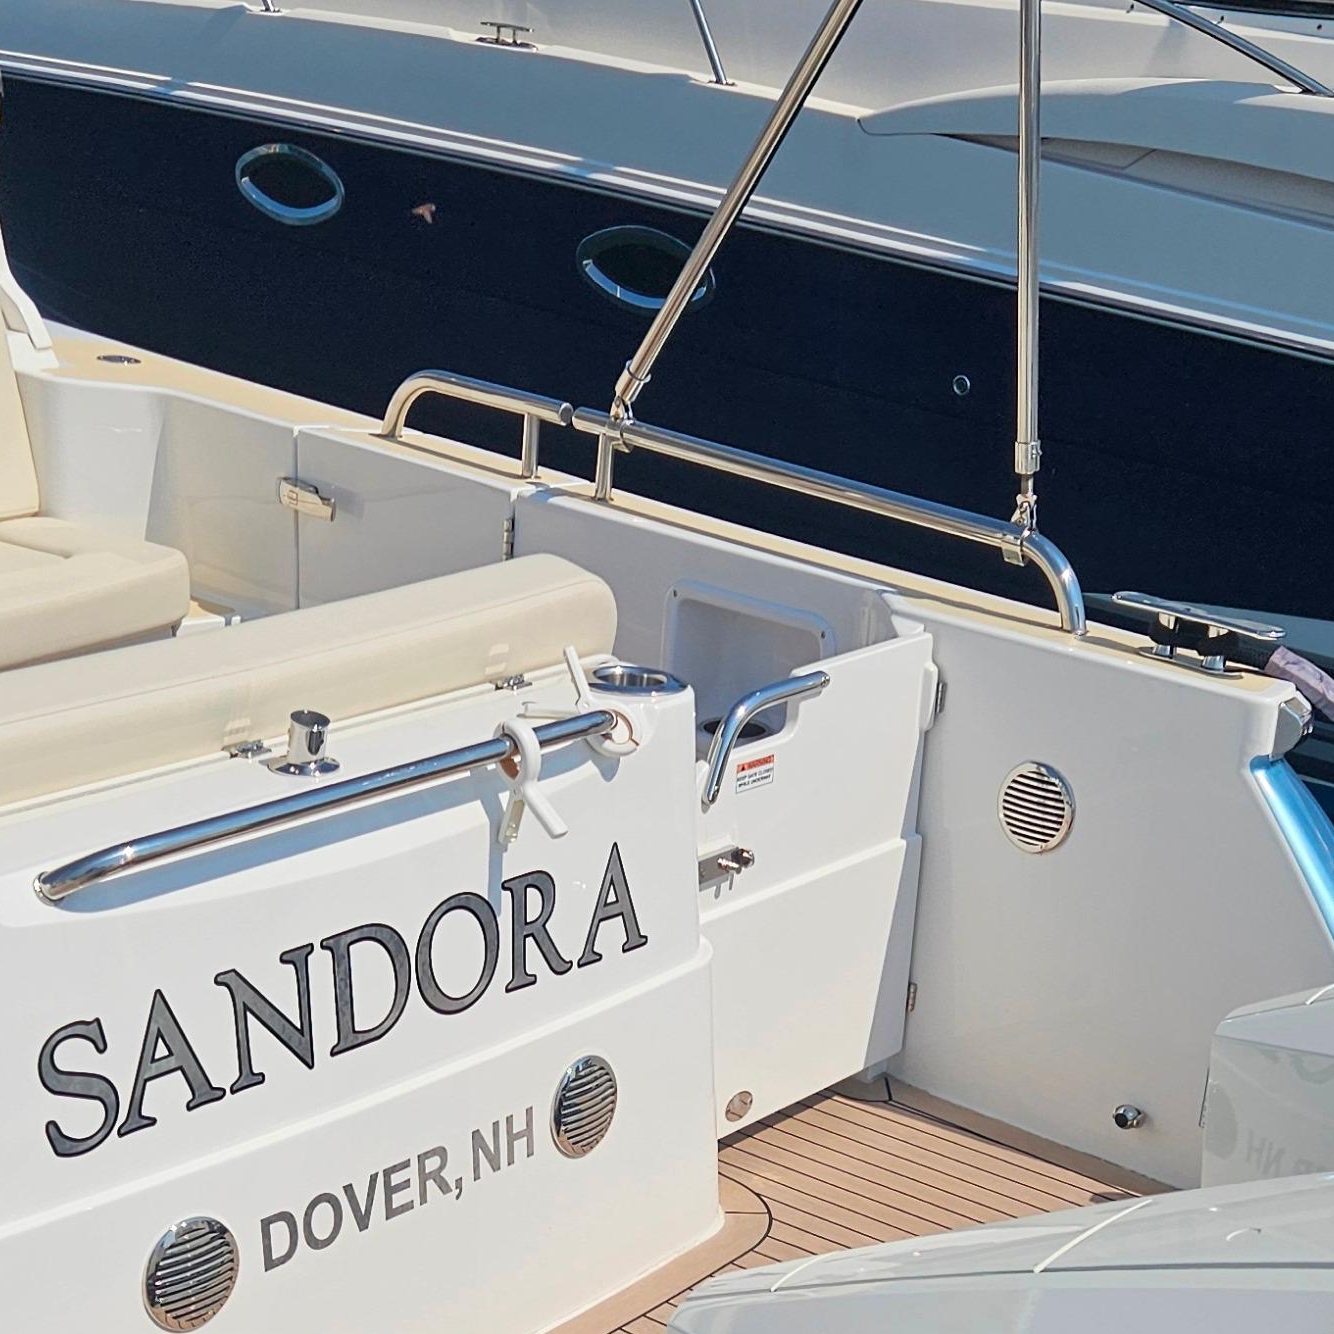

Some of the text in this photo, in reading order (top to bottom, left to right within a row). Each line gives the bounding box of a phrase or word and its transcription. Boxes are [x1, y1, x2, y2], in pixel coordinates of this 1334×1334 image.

[37, 842, 649, 1158] SANDORA
[260, 1105, 535, 1273] DOVER, NH
